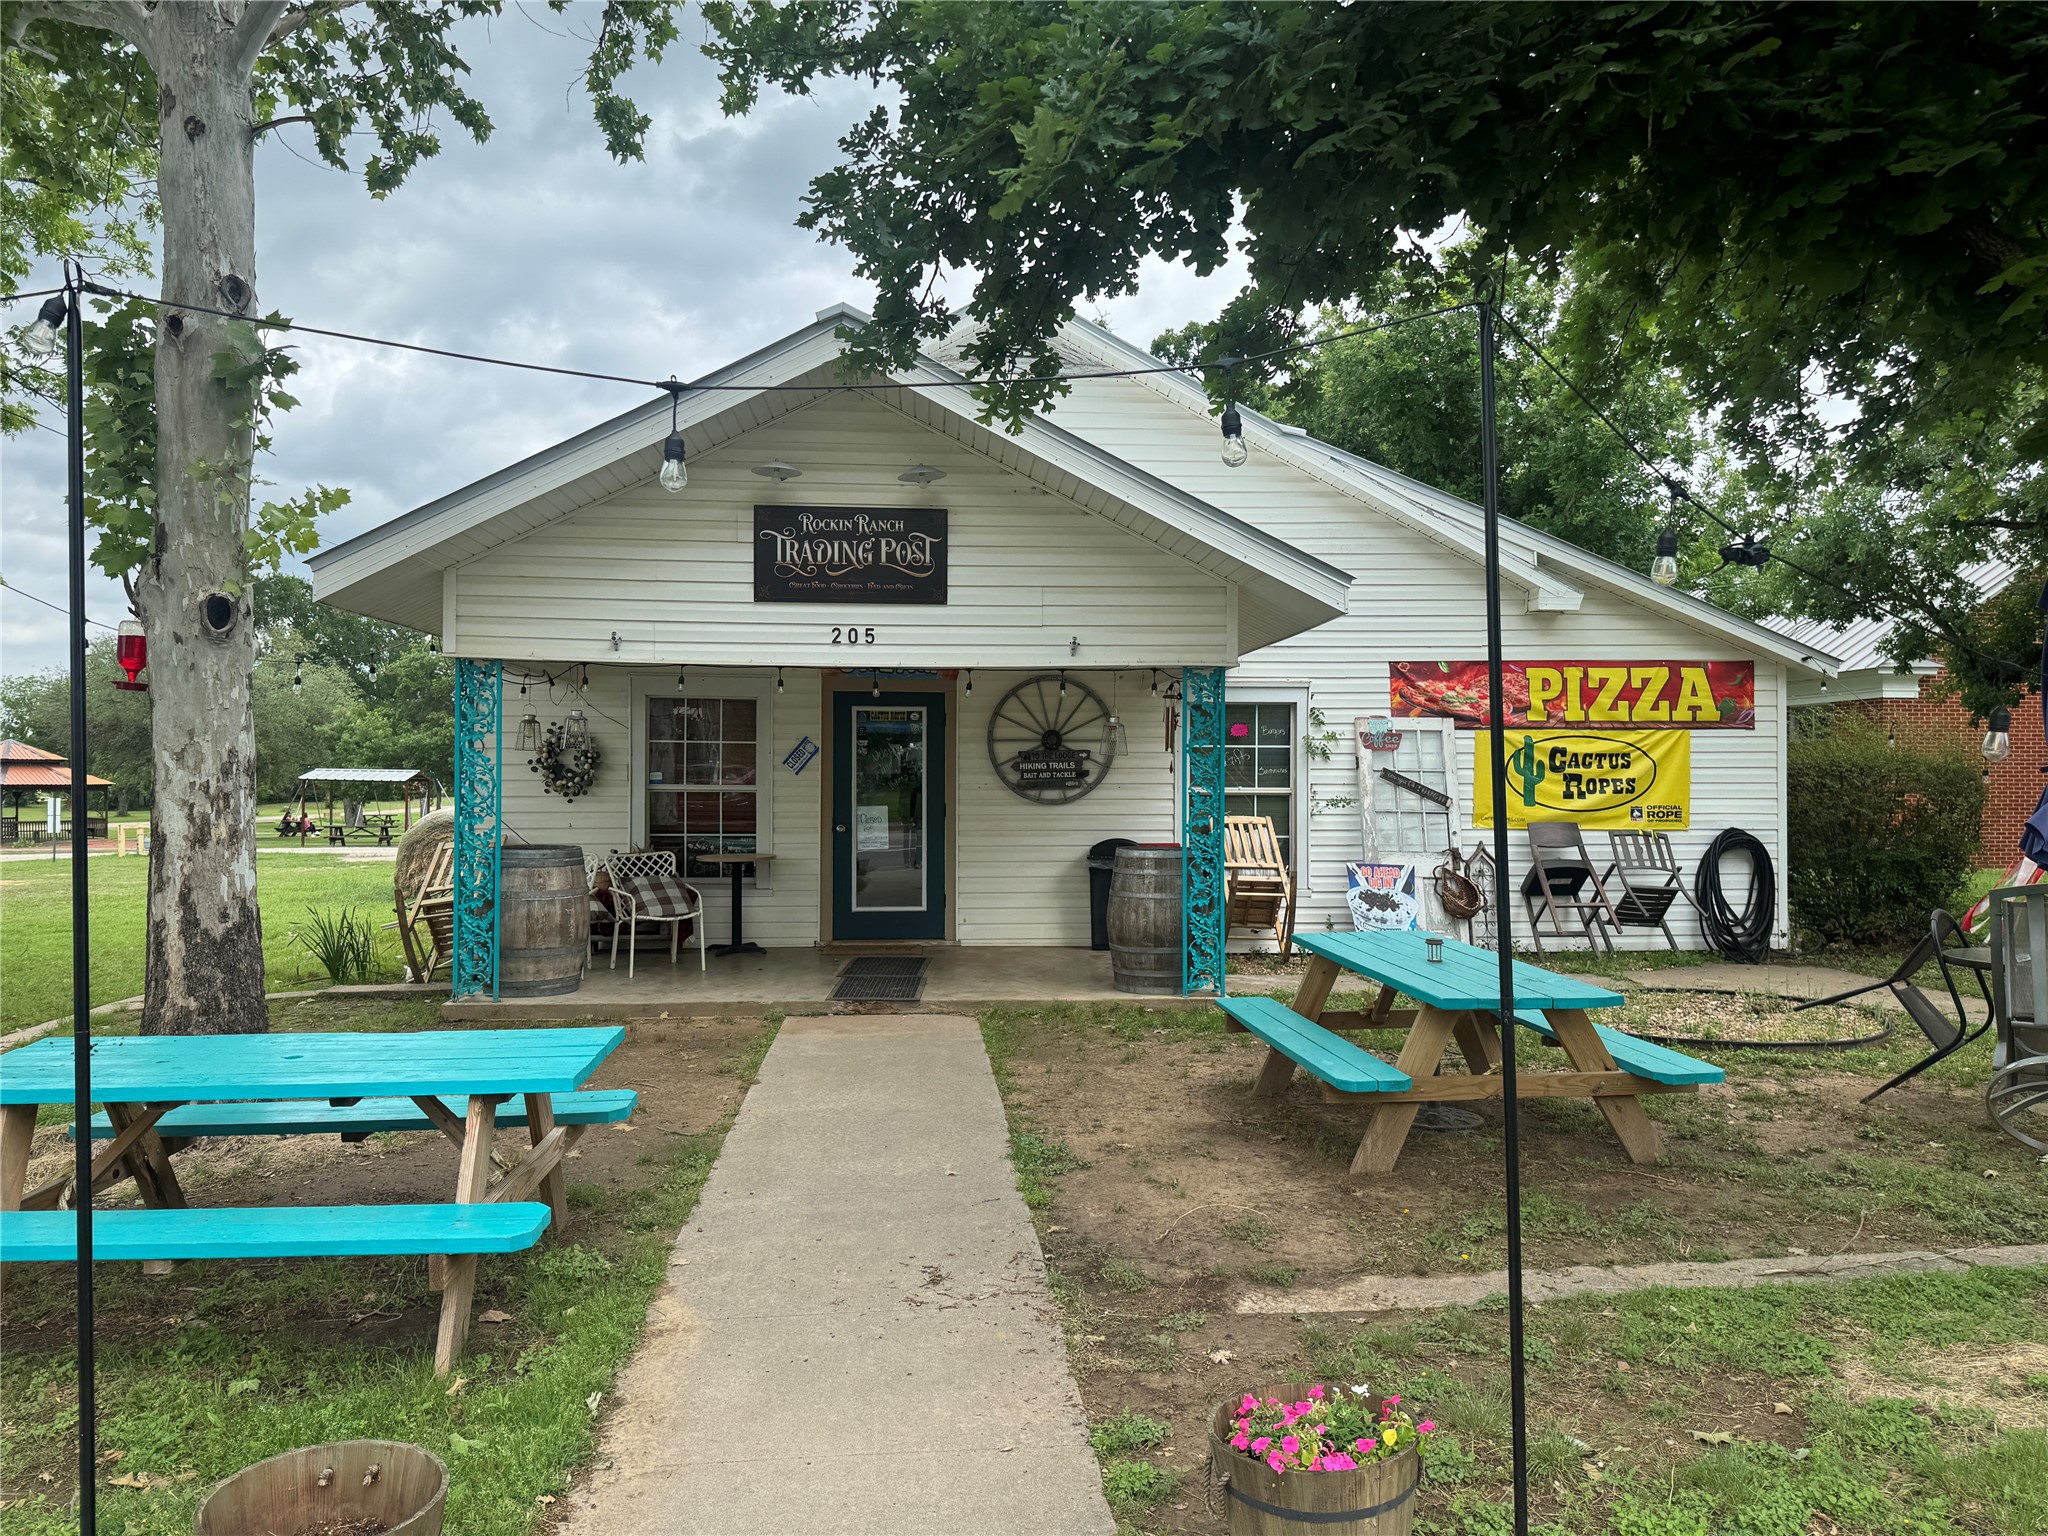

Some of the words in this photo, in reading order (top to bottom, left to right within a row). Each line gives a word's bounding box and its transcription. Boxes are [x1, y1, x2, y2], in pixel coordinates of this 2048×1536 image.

[854, 513, 905, 536] RANCH
[759, 527, 876, 577] TRADING
[879, 532, 942, 577] POST
[831, 627, 875, 644] 205
[1525, 666, 1721, 722] PIZZA
[1361, 730, 1400, 748] Coffee
[786, 748, 806, 769] CLOSED
[1019, 762, 1047, 770] HIKING
[1048, 761, 1076, 769] TRAILS
[1548, 746, 1632, 773] CACTUS
[1562, 772, 1636, 800] ROPES
[1646, 810, 1682, 819] ROPE
[1360, 866, 1373, 877] GO
[1373, 867, 1401, 879] AHEAD
[1369, 877, 1382, 889] DIG
